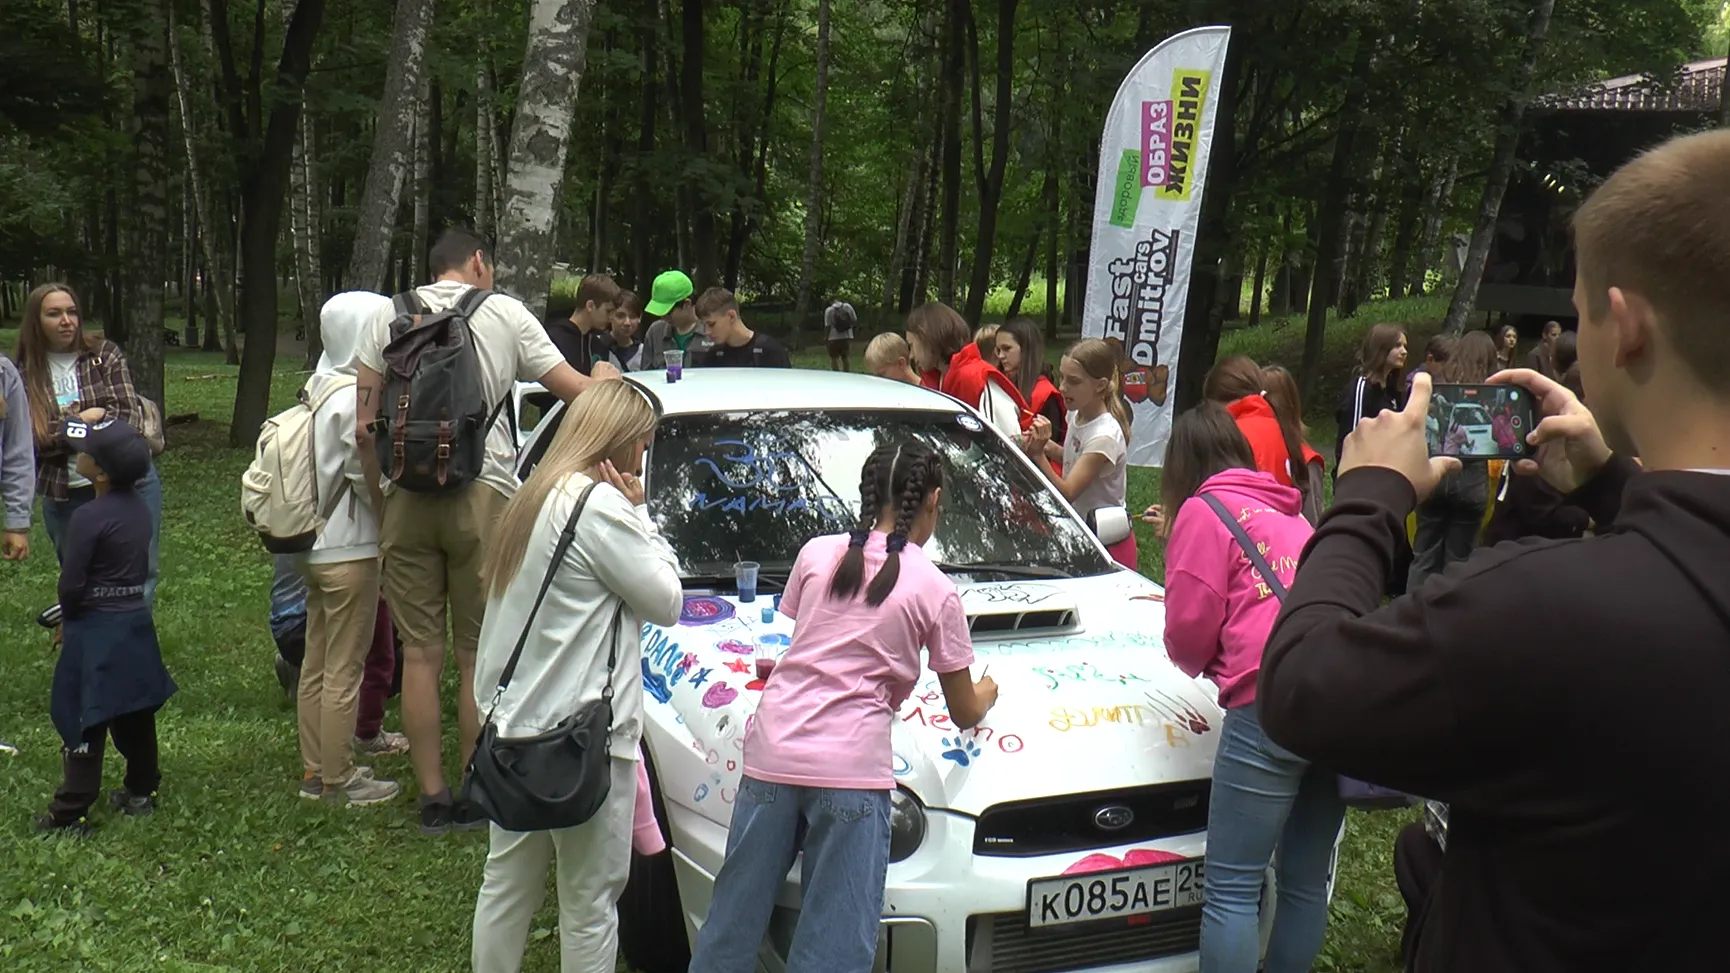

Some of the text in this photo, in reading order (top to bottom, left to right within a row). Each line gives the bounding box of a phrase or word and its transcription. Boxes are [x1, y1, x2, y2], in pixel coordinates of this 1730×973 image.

[1147, 102, 1168, 184] ОБРАЗ
[1165, 76, 1201, 194] ЖИЗНИ
[1105, 257, 1136, 342] Fast
[1131, 229, 1171, 367] Dmitrov
[1133, 241, 1151, 284] cars
